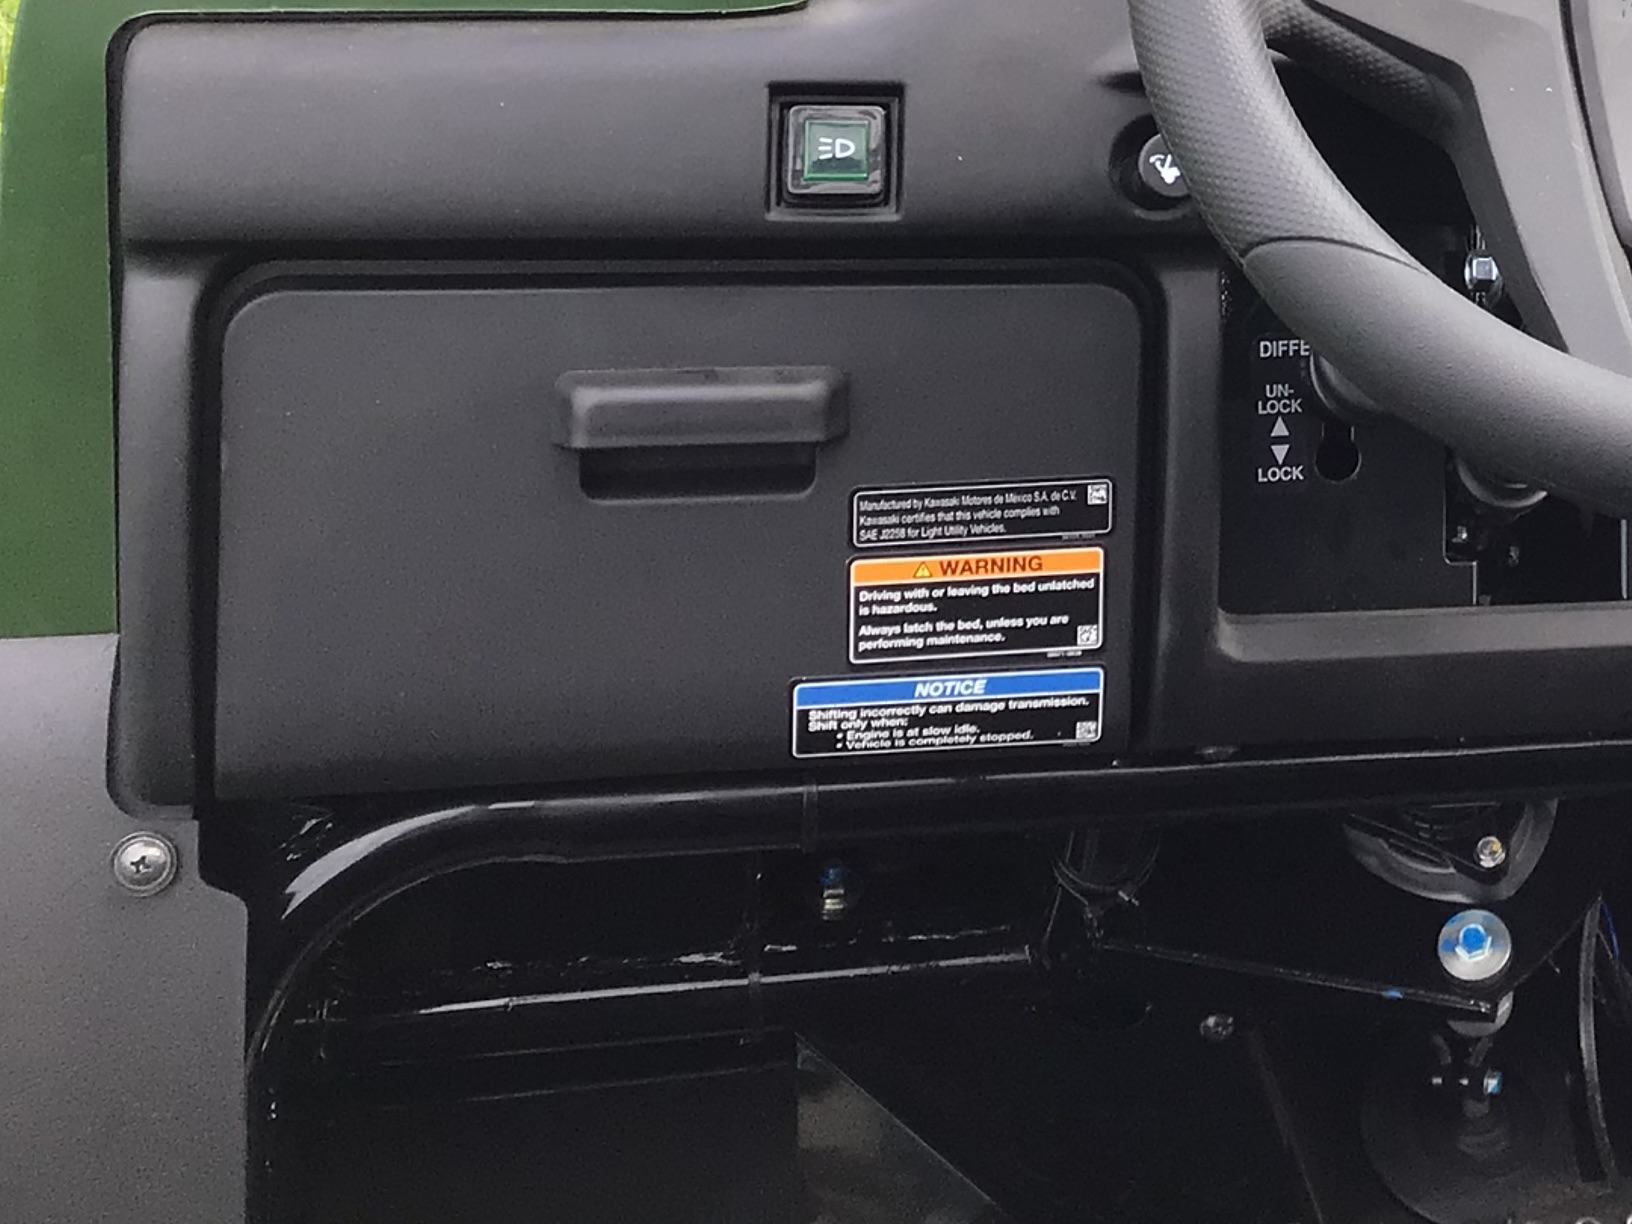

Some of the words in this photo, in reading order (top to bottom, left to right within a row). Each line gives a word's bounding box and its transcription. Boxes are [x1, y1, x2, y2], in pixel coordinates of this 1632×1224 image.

[1265, 384, 1295, 398] UN-
[1258, 399, 1303, 415] LOCK
[1257, 466, 1305, 482] LOCK
[859, 499, 911, 511] Manufactured
[913, 499, 923, 511] by
[924, 496, 960, 509] Kawasaki
[994, 494, 1003, 505] de
[1050, 490, 1060, 501] de
[859, 514, 899, 526] Kawasaki
[901, 512, 935, 524] certifies
[937, 511, 954, 522] that
[955, 510, 971, 521] this
[973, 508, 1002, 520] vehicle
[1003, 506, 1040, 519] complies
[1042, 505, 1060, 516] with
[859, 528, 878, 541] SAE
[907, 526, 919, 538] for
[921, 525, 942, 540] Light
[944, 524, 968, 537] Utility
[970, 523, 1006, 535] Vehicles.
[939, 556, 1044, 577] WARNING
[859, 590, 901, 603] Driving
[904, 587, 929, 599] with
[932, 588, 945, 598] or
[947, 584, 989, 597] leaving
[992, 583, 1011, 595] the
[1013, 581, 1036, 593] bed
[1037, 578, 1095, 592] unlatched
[859, 605, 869, 616] is
[872, 602, 938, 615] hazardous.
[858, 624, 901, 636] Always
[903, 620, 933, 633] latch
[936, 619, 955, 631] the
[957, 618, 984, 630] bed,
[986, 616, 1024, 629] unless
[1026, 616, 1047, 629] you
[1050, 615, 1069, 625] are
[858, 637, 924, 652] performing
[926, 632, 1007, 646] maintenance.
[914, 679, 988, 698] NOTICE
[808, 708, 857, 721] Shifting
[859, 704, 927, 718] incorrectly
[928, 704, 953, 714] can
[955, 701, 1005, 714] damage
[1008, 696, 1090, 709] transmission.
[808, 719, 838, 732] Shift
[840, 718, 868, 731] only
[870, 717, 908, 728] when:
[846, 729, 889, 742] Engine
[892, 729, 904, 739] is
[906, 727, 919, 737] at
[921, 725, 952, 736] slow
[954, 723, 980, 735] idle.
[846, 740, 892, 751] Vehicle
[894, 737, 905, 747] is
[907, 734, 977, 746] completely
[980, 730, 1035, 743] stopped.
